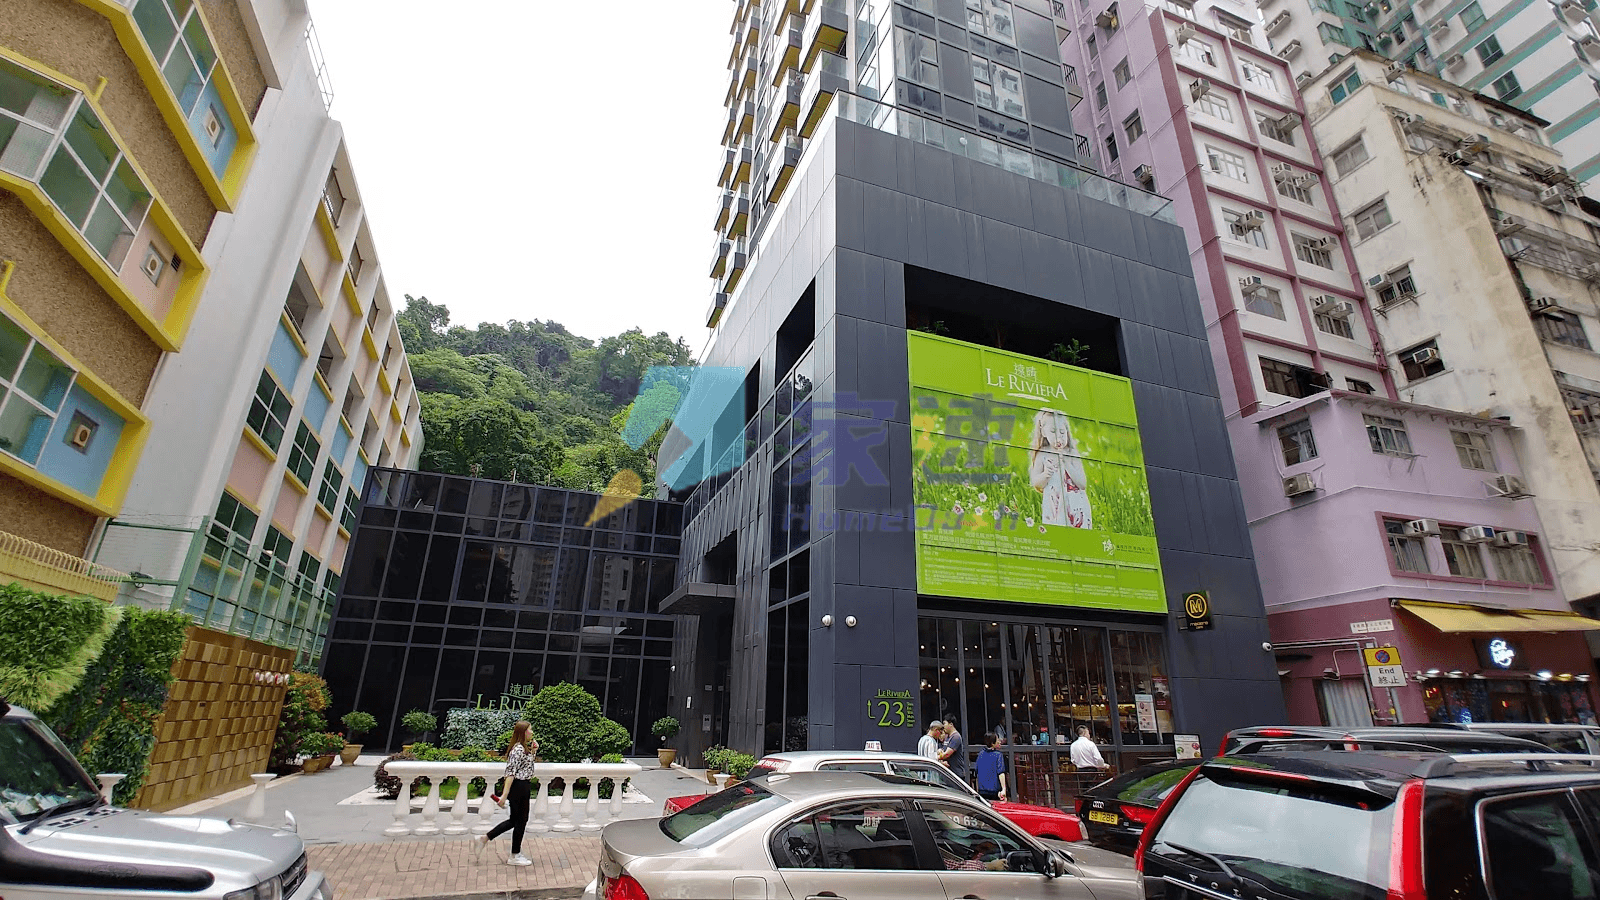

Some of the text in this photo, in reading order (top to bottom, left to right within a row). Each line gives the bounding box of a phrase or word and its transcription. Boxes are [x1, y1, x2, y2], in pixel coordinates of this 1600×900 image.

[985, 368, 1069, 400] LE RIVIERA
[477, 693, 497, 711] LE
